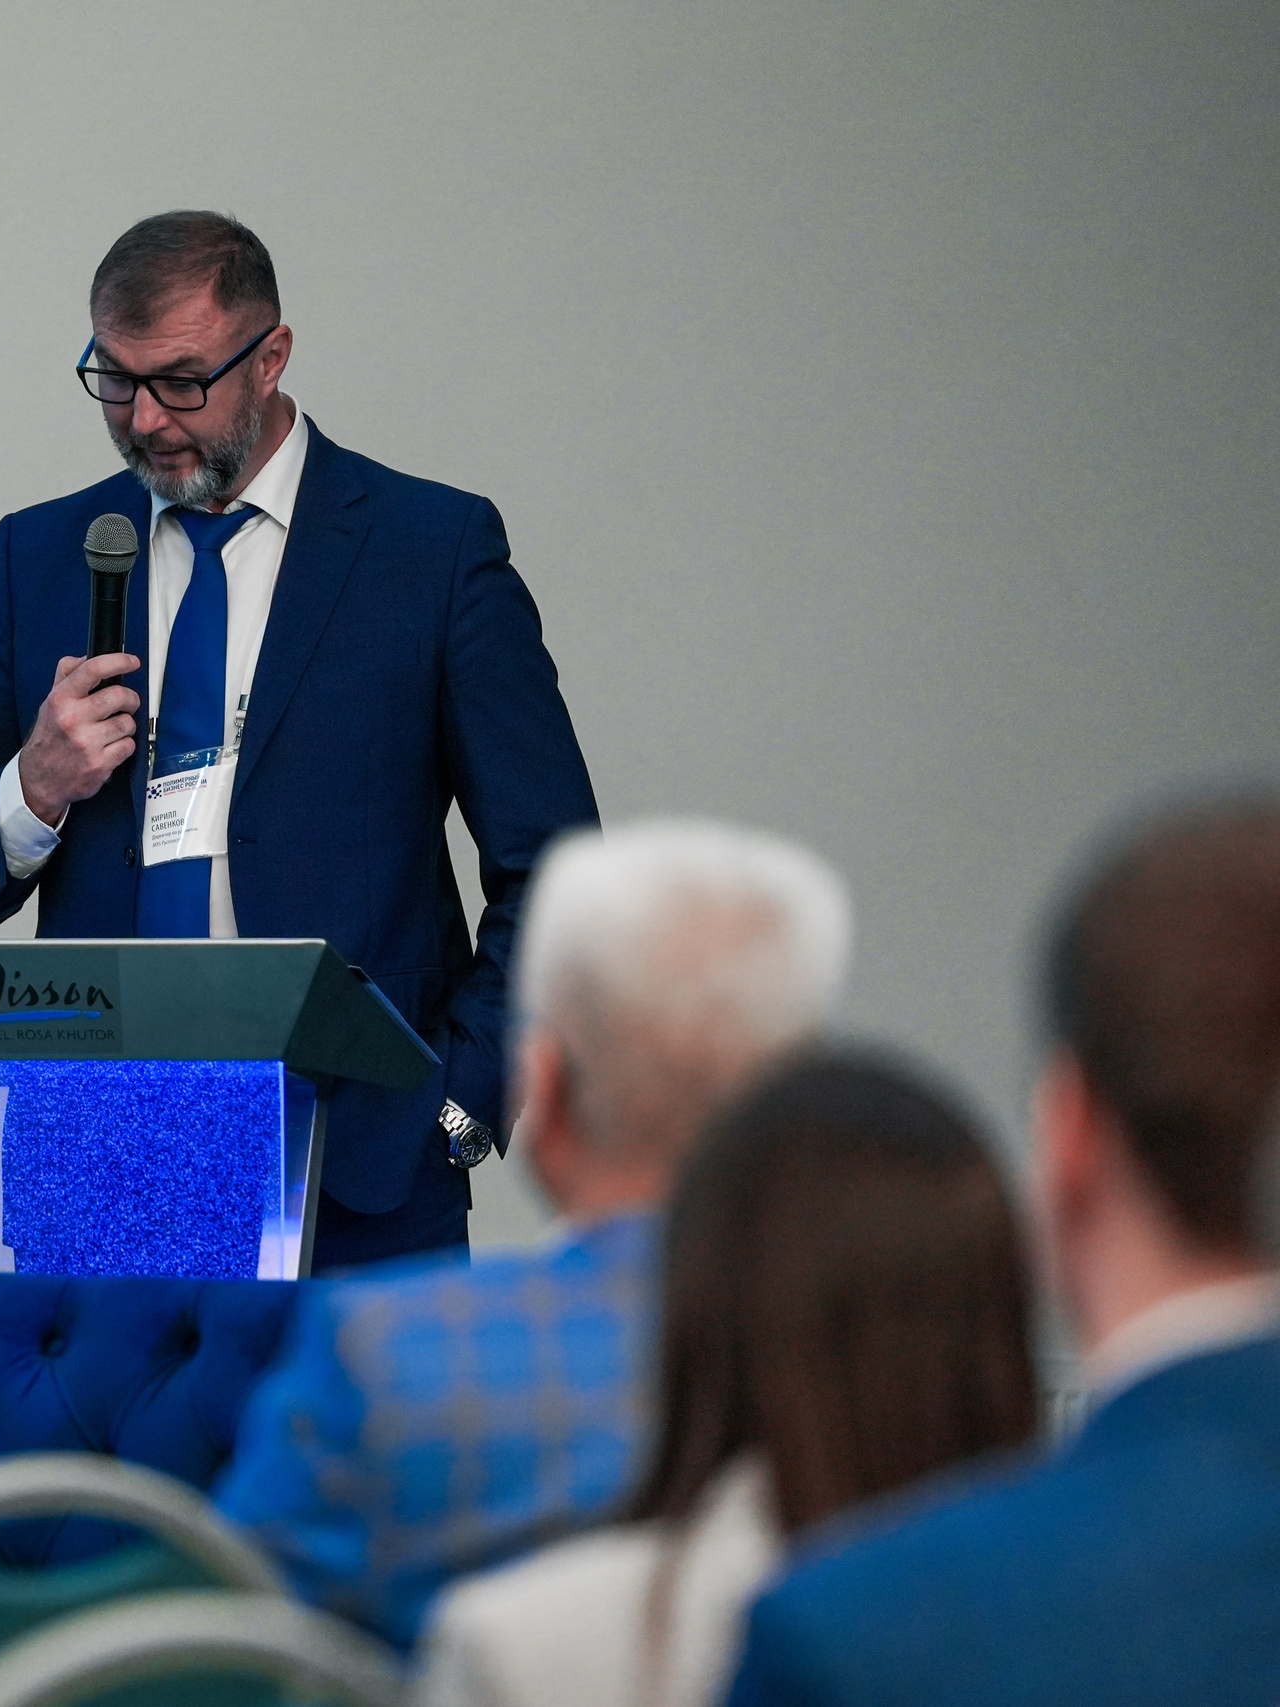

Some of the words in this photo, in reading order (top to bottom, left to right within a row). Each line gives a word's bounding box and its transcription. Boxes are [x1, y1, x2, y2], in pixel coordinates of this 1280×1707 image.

[151, 810, 177, 823] КИРИЛЛ
[151, 818, 185, 832] САВЕНКОВ
[17, 1029, 52, 1040] ROSA
[58, 1029, 114, 1040] KHUTOR
